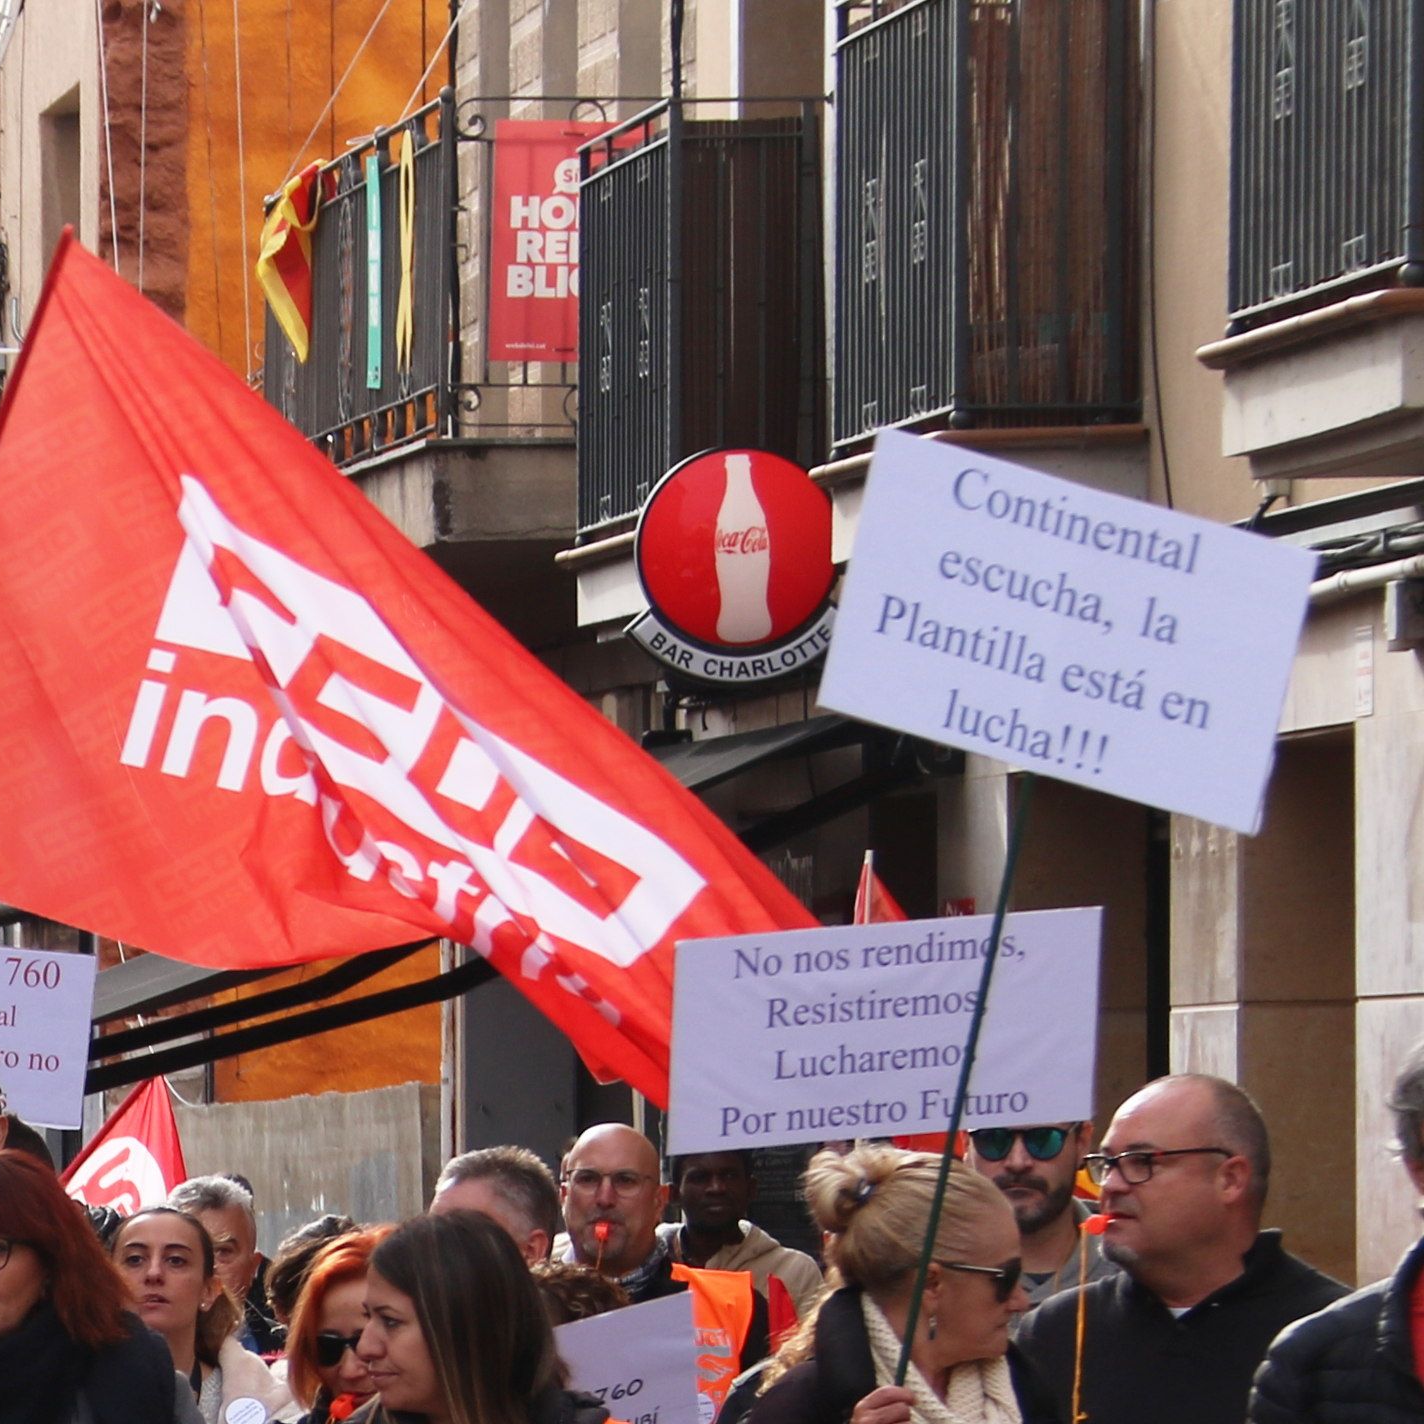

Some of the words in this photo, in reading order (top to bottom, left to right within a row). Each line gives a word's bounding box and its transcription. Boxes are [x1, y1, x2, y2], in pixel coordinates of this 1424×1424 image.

[510, 195, 579, 229] HO
[953, 467, 1201, 574] Continental
[939, 549, 1114, 634] escucha,
[1140, 597, 1179, 645] la
[649, 632, 694, 669] BAR
[703, 625, 832, 678] CHARLOTTE
[872, 594, 1046, 682] Plantilla
[1060, 661, 1146, 711] está
[1160, 690, 1211, 730] en
[941, 688, 1111, 775] lucha!!!
[5, 956, 61, 990] 760
[733, 947, 783, 979] No
[793, 947, 850, 974] nos
[861, 931, 1026, 969] rendimos,
[29, 1051, 60, 1073] no
[773, 1043, 970, 1080] Lucharemo
[719, 1106, 777, 1137] Por
[787, 1097, 907, 1130] nuestro
[919, 1088, 1030, 1120] Futuro
[594, 1379, 643, 1401] 760
